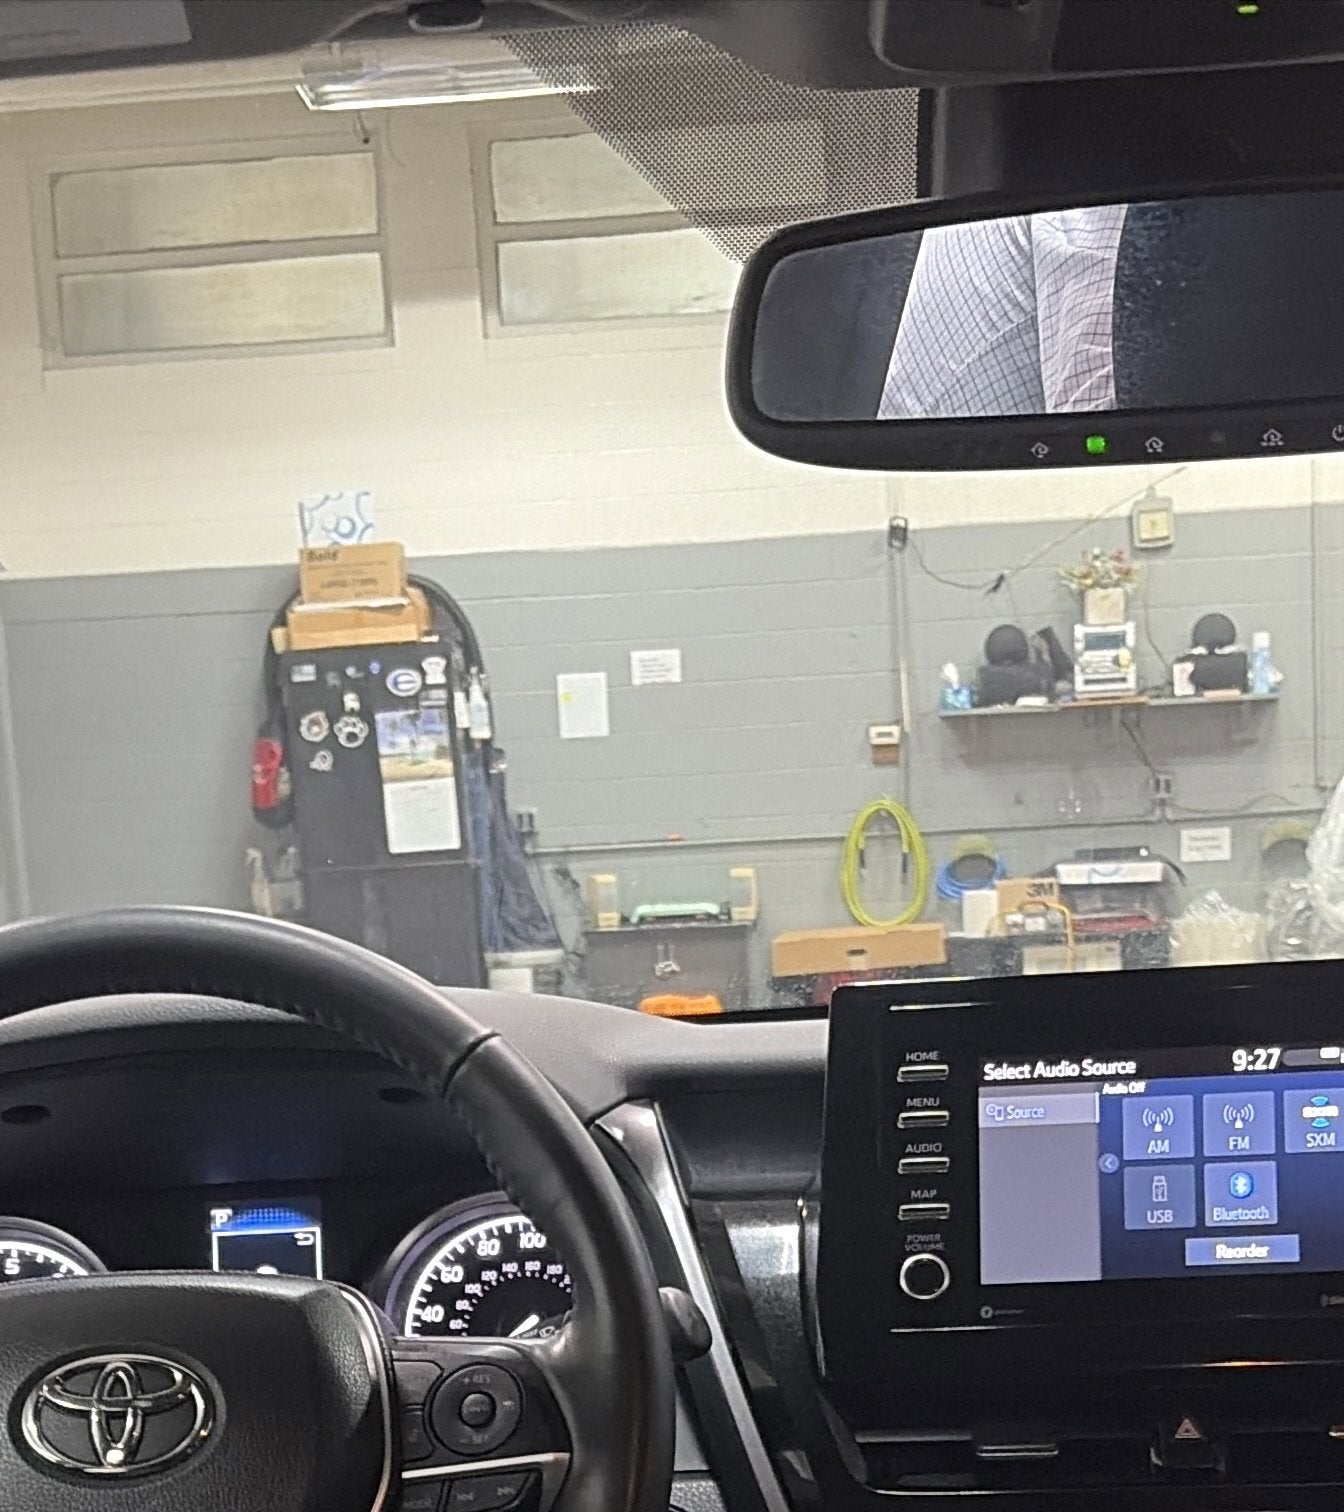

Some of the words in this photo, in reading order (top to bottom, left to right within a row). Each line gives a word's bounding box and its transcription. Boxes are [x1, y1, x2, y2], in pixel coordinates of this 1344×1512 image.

[1026, 882, 1055, 897] 3M
[906, 1051, 938, 1062] HOME
[1232, 1048, 1281, 1071] 9:27
[983, 1064, 1031, 1081] Select
[1033, 1061, 1079, 1078] Audio
[1082, 1059, 1136, 1076] Source
[906, 1097, 940, 1108] MENU
[1006, 1105, 1045, 1119] Source
[905, 1143, 942, 1153] AUDIO
[1148, 1140, 1169, 1154] AM
[1229, 1137, 1250, 1150] FM
[1306, 1133, 1336, 1147] SXM
[910, 1189, 937, 1199] MAP
[1147, 1210, 1173, 1223] USB
[1213, 1205, 1270, 1221] Bluetooth
[519, 1232, 546, 1248] 100
[906, 1233, 941, 1242] POWER
[477, 1239, 500, 1256] 80
[904, 1241, 945, 1251] VOLUME
[1216, 1244, 1270, 1259] Reorder
[4, 1258, 20, 1275] 5
[441, 1265, 463, 1283] 60
[502, 1262, 518, 1272] 140
[481, 1271, 497, 1281] 120
[465, 1284, 481, 1294] 100
[420, 1305, 444, 1323] 40
